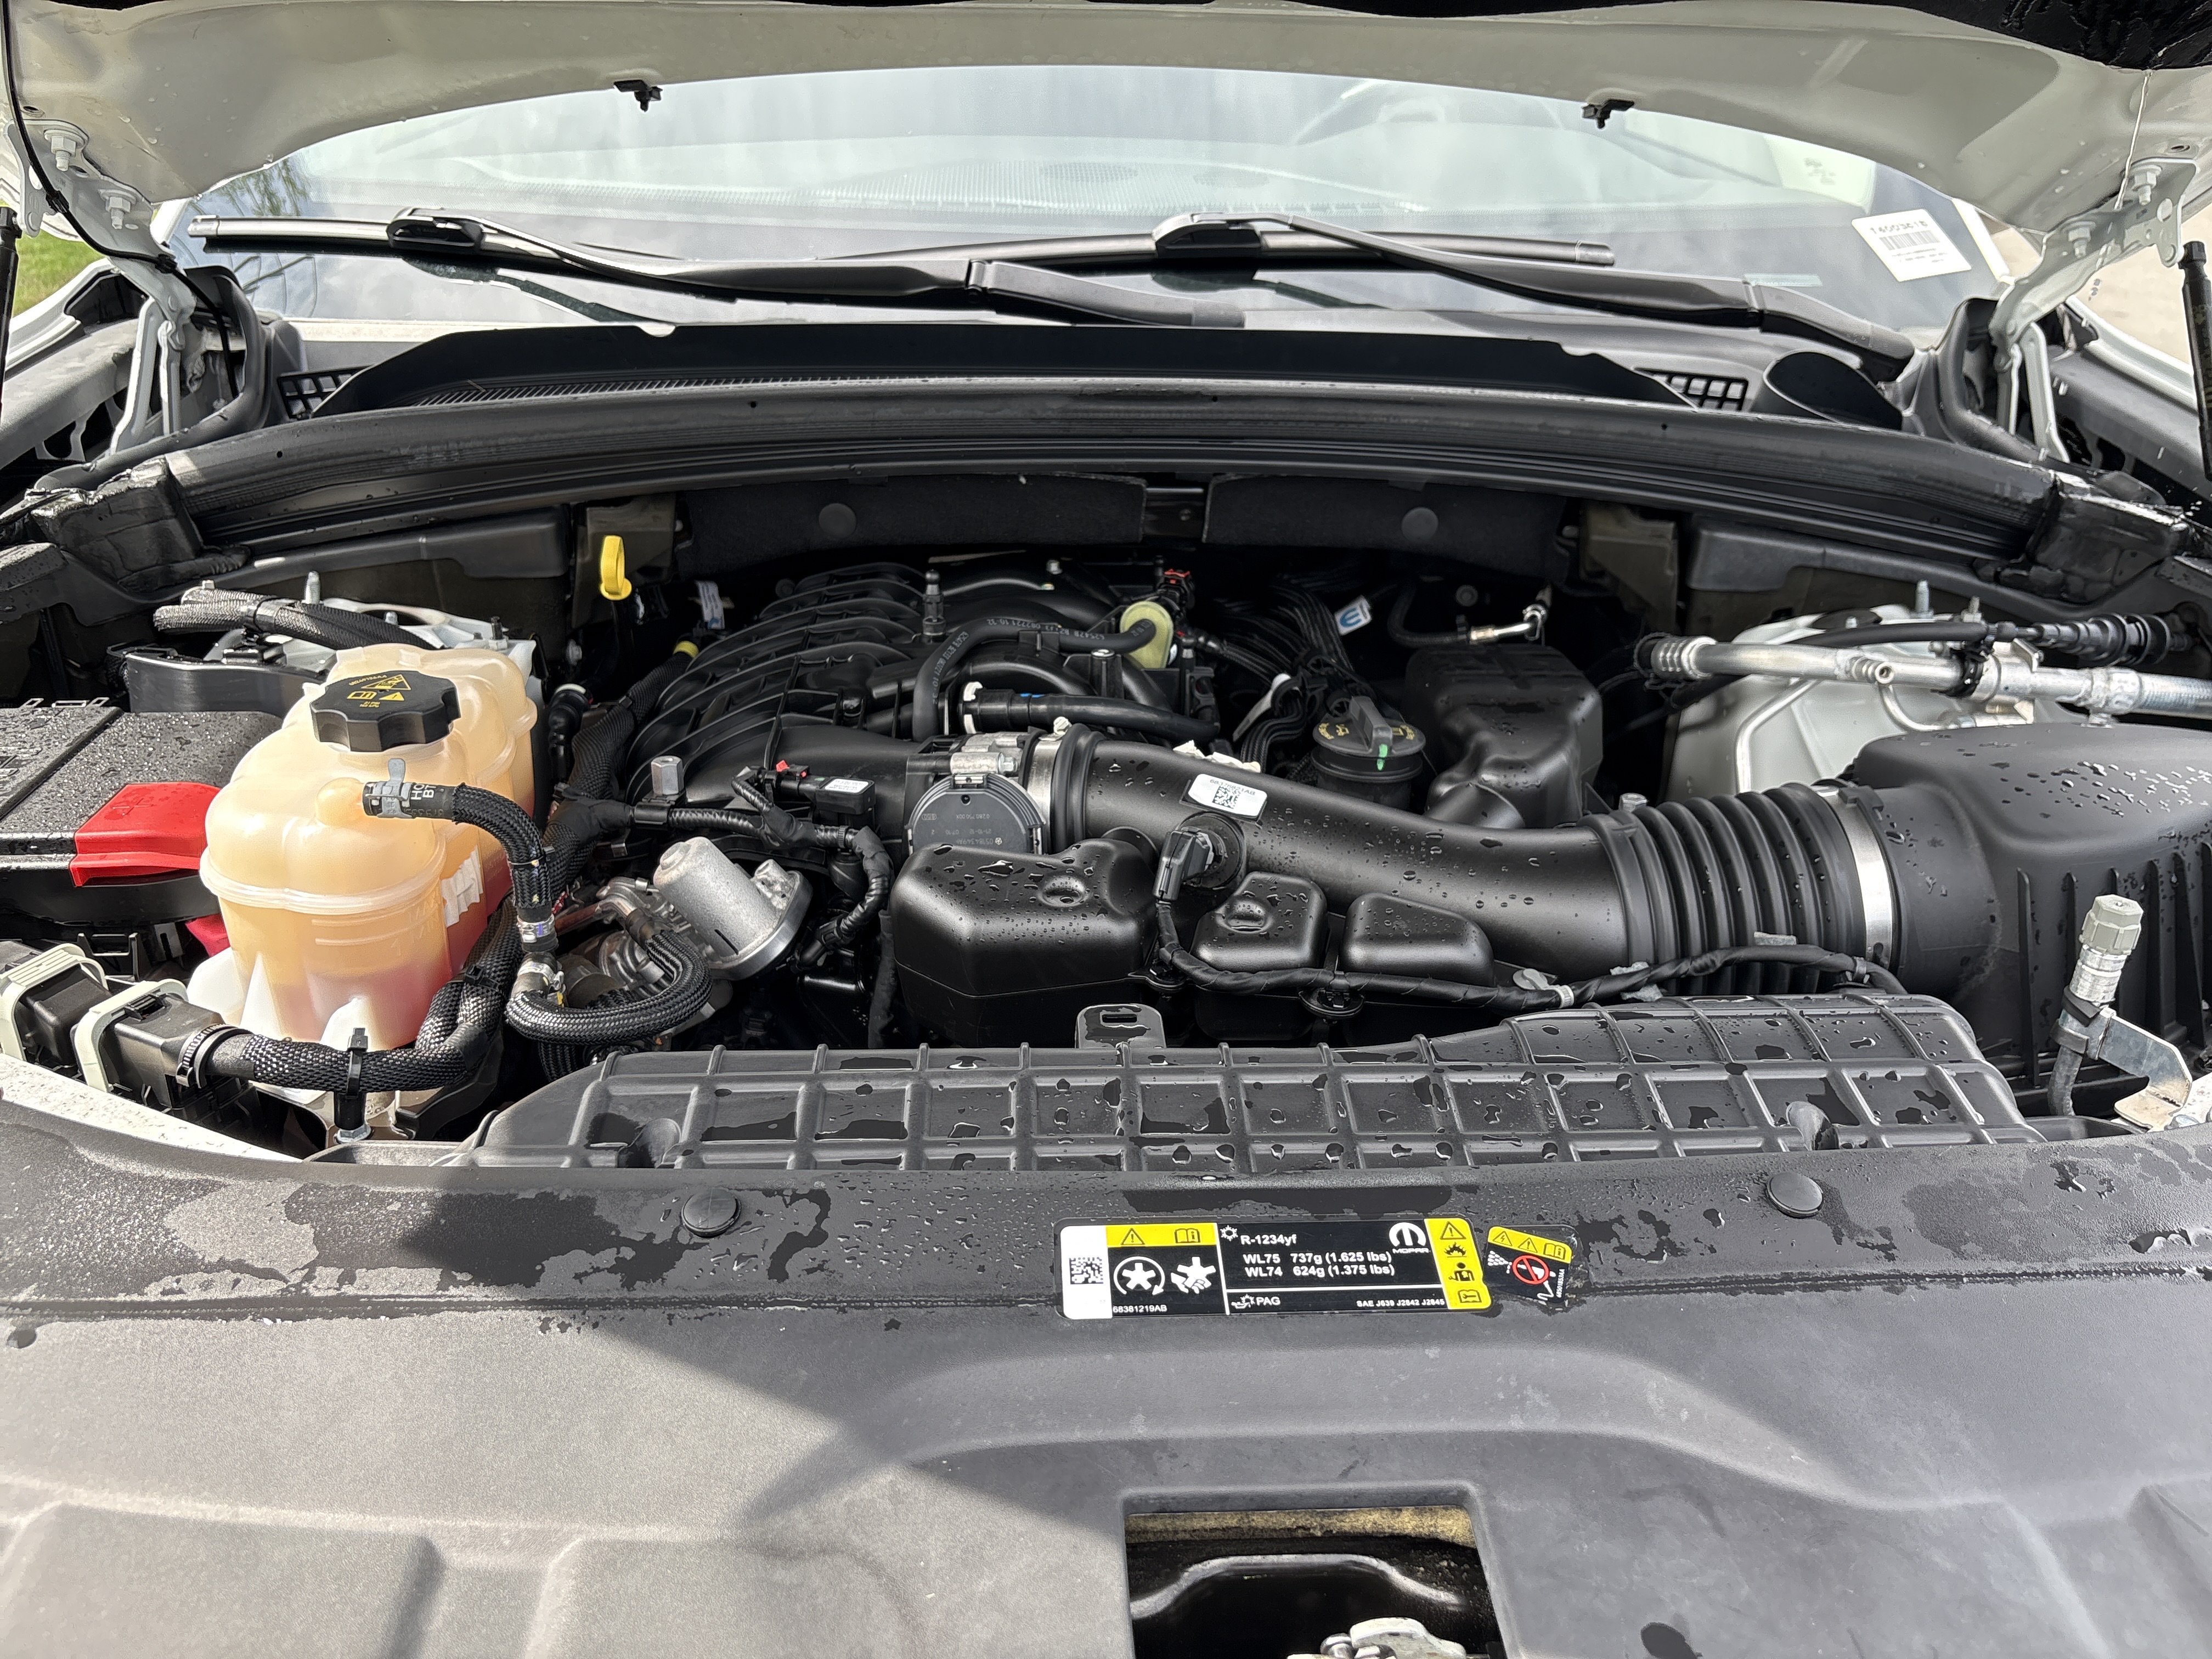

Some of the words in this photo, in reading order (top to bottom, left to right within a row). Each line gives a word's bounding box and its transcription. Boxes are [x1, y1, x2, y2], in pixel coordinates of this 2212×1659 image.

[1240, 1234, 1297, 1246] R-1234yf
[1243, 1254, 1280, 1264] WL75
[1290, 1252, 1323, 1265] 737g
[1325, 1251, 1364, 1265] (1.625
[1367, 1251, 1392, 1263] lbs)
[1245, 1266, 1283, 1277] WL74
[1293, 1266, 1325, 1278] 624g
[1328, 1264, 1367, 1277] (1.375
[1369, 1264, 1395, 1276] lbs)
[1256, 1296, 1280, 1306] PAG
[1113, 1305, 1167, 1313] 68381219AB
